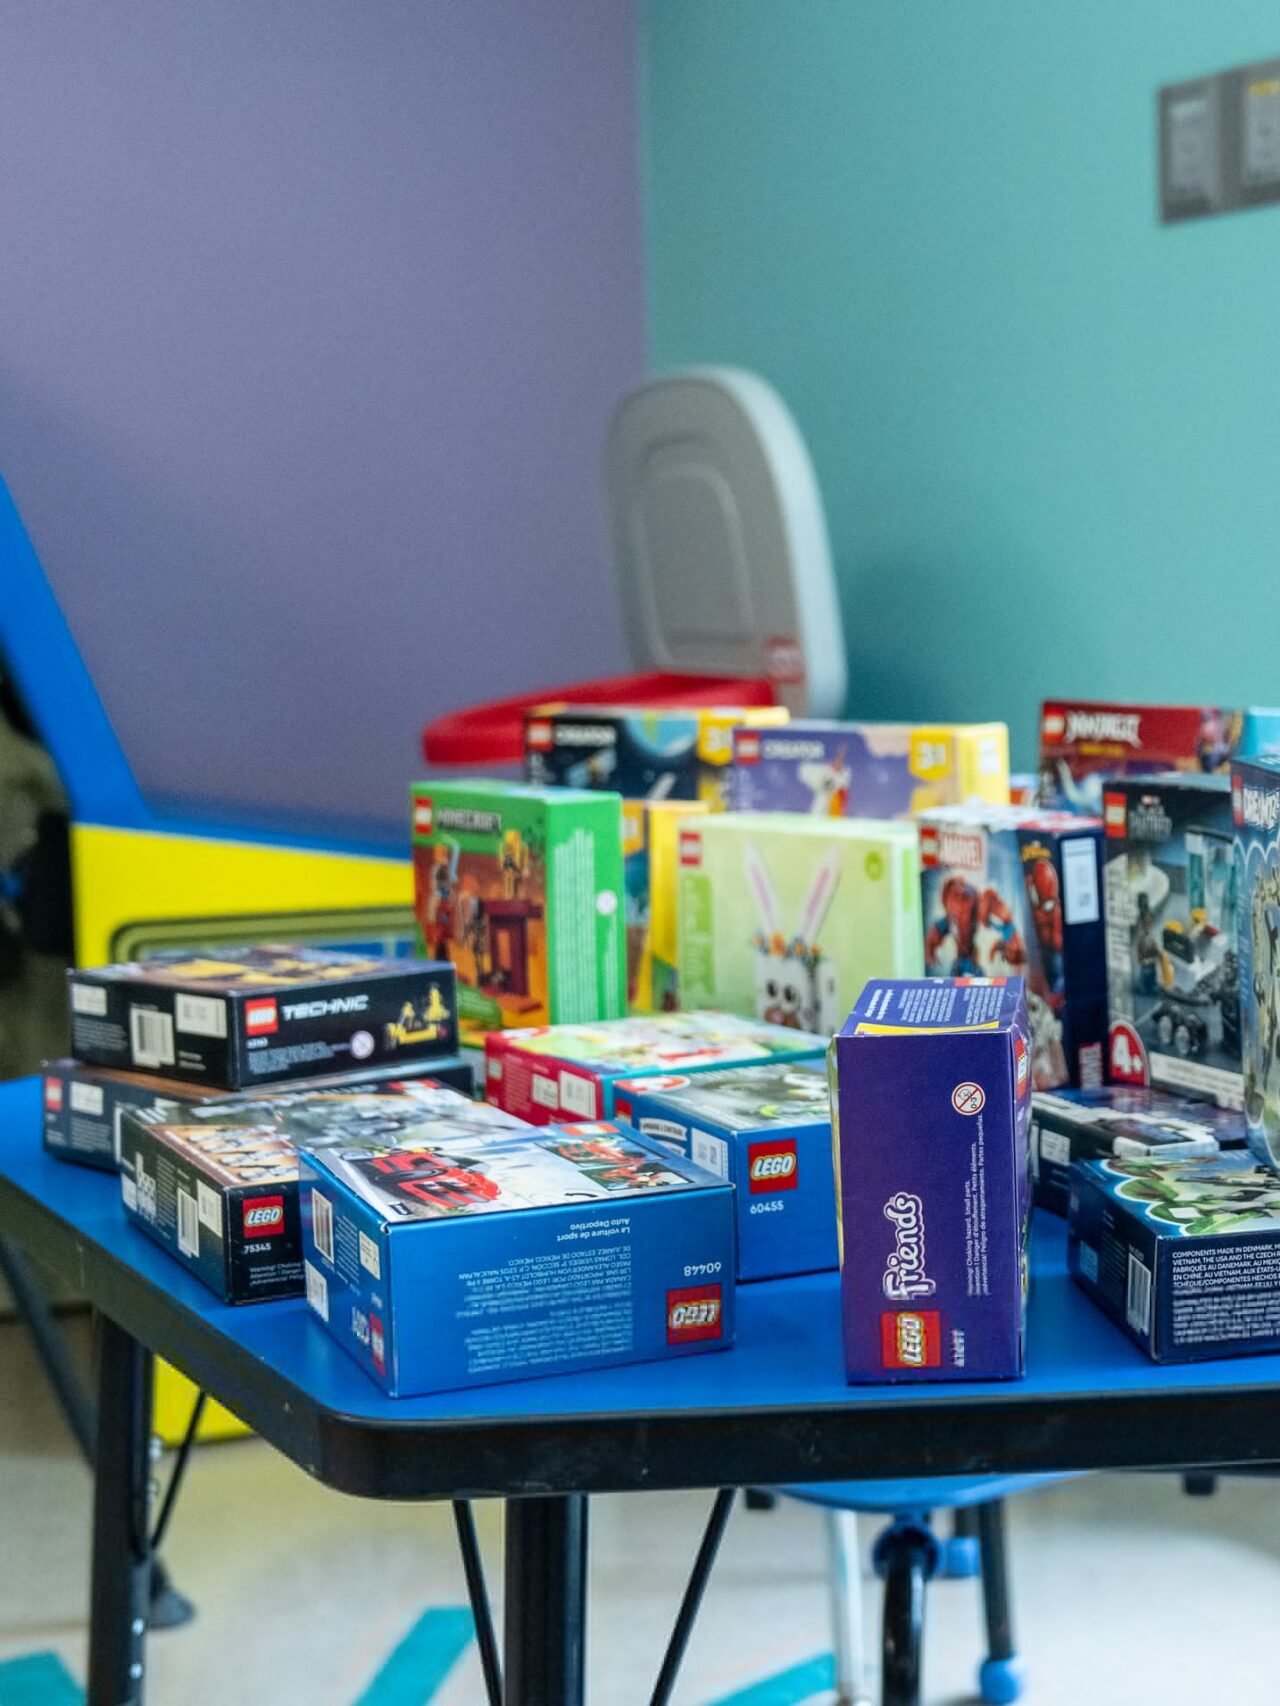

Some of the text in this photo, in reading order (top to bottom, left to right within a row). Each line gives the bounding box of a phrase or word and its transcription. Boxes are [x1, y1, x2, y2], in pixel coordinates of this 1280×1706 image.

[281, 994, 369, 1021] TECHNIC
[970, 1094, 978, 1110] 0-3
[752, 1154, 794, 1179] LEGO
[246, 1206, 281, 1226] LEGO
[750, 1201, 785, 1215] 60455
[570, 1217, 629, 1232] Auto Deportivo
[979, 1221, 985, 1229] de
[556, 1226, 630, 1242] La voiture de sport
[243, 1242, 272, 1255] 75345
[882, 1191, 937, 1302] Friends
[683, 1262, 722, 1278] 60448
[669, 1303, 718, 1330] LEGO
[897, 1314, 926, 1366] LEGO
